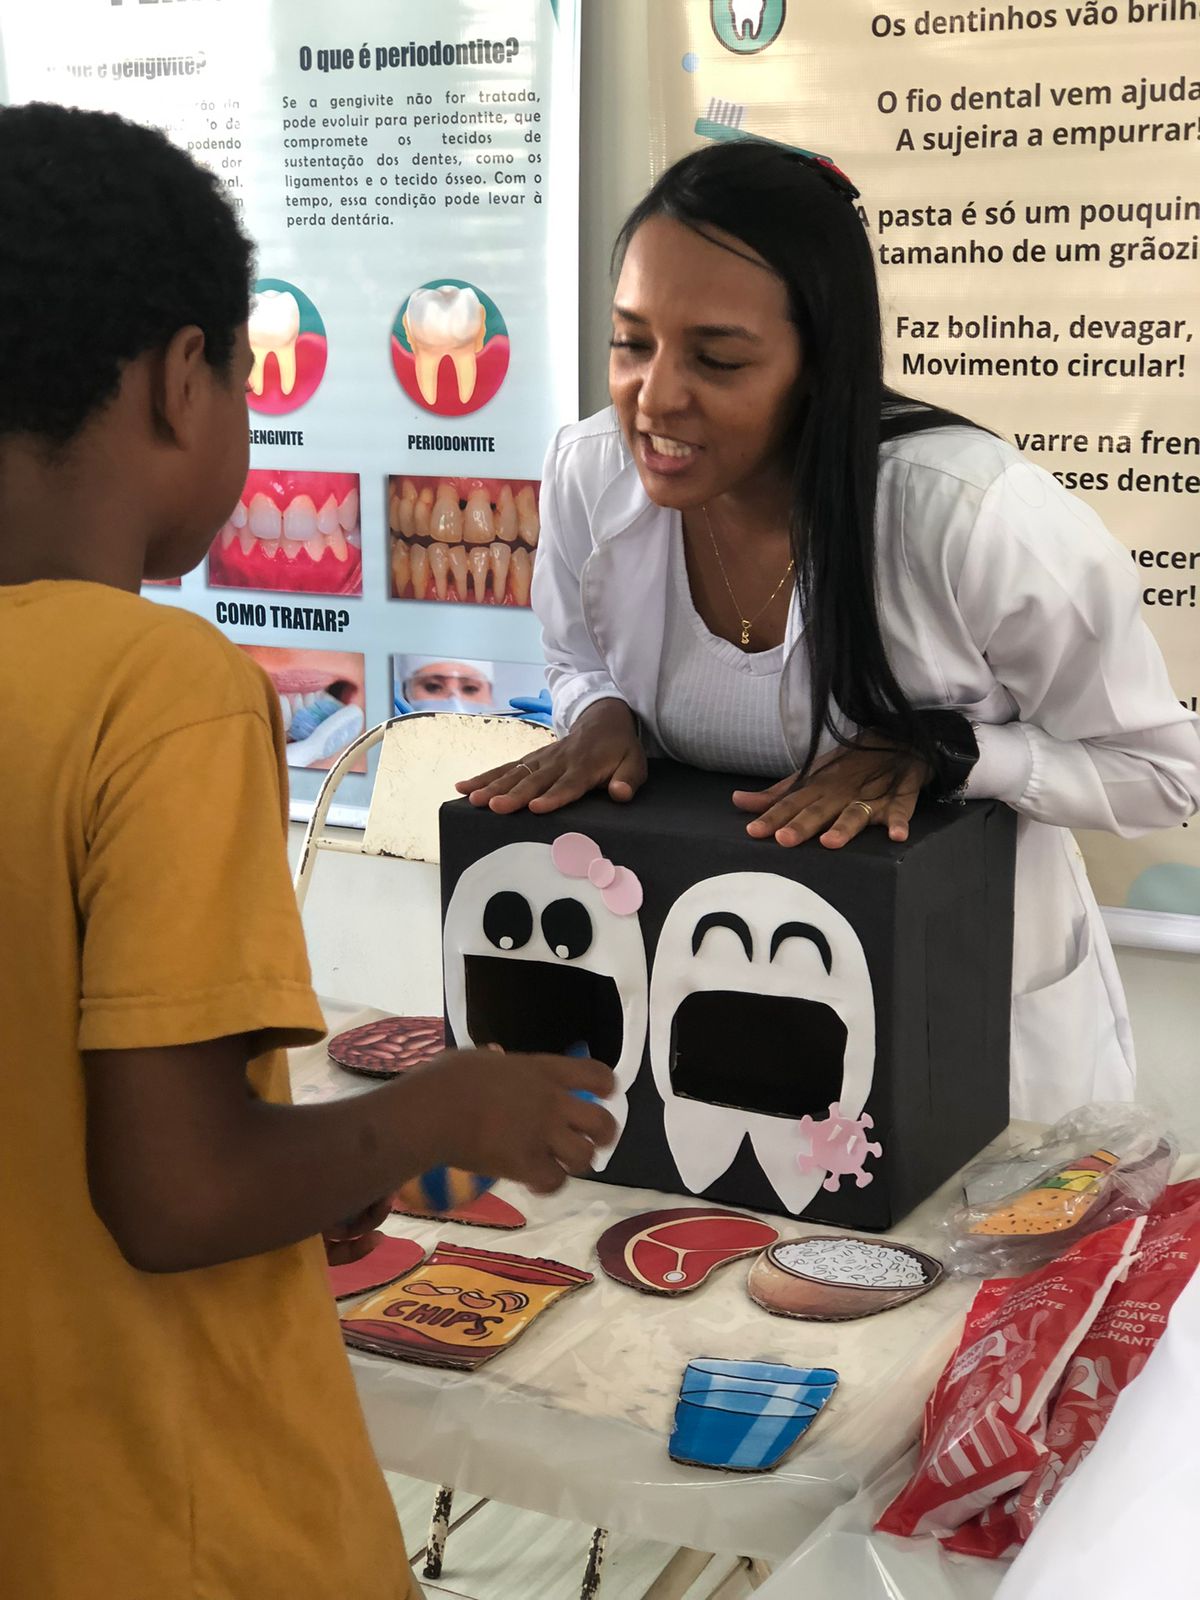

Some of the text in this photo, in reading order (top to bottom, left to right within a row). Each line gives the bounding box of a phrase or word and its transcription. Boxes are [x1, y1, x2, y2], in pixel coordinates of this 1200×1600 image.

[871, 0, 1200, 37] Os dentinhos vão brilh
[299, 37, 519, 73] O que é periodontite?
[282, 89, 541, 109] Se a gengivite não for tratada,
[877, 91, 898, 114] O
[906, 88, 942, 113] fio
[950, 83, 1041, 111] dental
[1050, 86, 1112, 107] vem
[283, 111, 541, 131] pode evoluir para periodontite, que
[187, 138, 242, 151] podendo
[283, 130, 542, 149] compromete os tecidos de
[896, 129, 915, 151] A
[922, 125, 1018, 156] sujeira
[1027, 128, 1043, 146] a
[284, 153, 542, 170] sustentação dos dentes, como os
[285, 171, 542, 189] ligamentos e o tecido ósseo. Com o
[286, 190, 542, 209] tempo, essa condição pode levar à
[287, 211, 394, 228] perda dentária.
[878, 205, 952, 234] pasta
[961, 202, 977, 225] é
[985, 201, 1016, 225] só
[1026, 204, 1070, 224] um
[879, 236, 1198, 268] tamanho de um grãozi
[897, 315, 1194, 345] Faz bolinha, devagar,
[902, 353, 1186, 377] Movimento circular!
[408, 435, 495, 452] PERIODONTITE
[1015, 432, 1089, 452] varre
[1098, 435, 1131, 453] na
[216, 601, 350, 632] COMO TRATAR?
[383, 1301, 504, 1335] CHIPS
